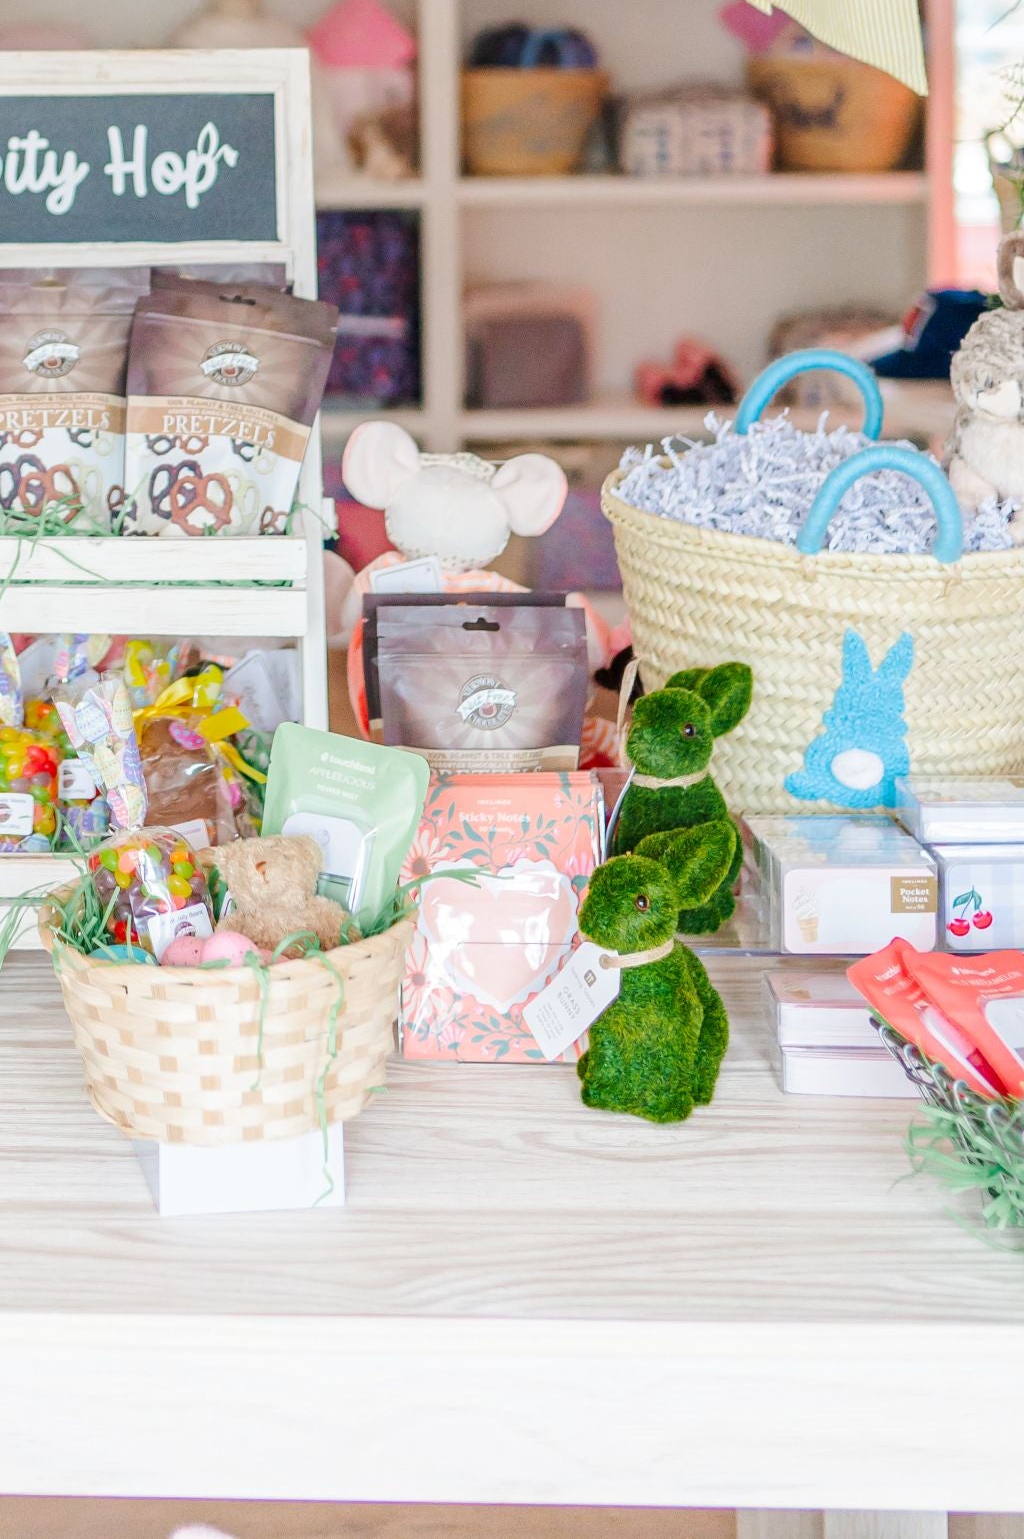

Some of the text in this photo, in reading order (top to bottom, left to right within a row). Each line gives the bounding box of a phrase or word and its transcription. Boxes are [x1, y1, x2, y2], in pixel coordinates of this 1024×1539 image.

[103, 121, 239, 209] Hop
[162, 414, 276, 449] PRETZELS
[329, 754, 376, 775] touchland
[458, 812, 530, 824] Sticky Notes
[899, 888, 930, 896] Pocket
[557, 991, 575, 1020] BUNNY
[563, 986, 581, 1015] GRASS
